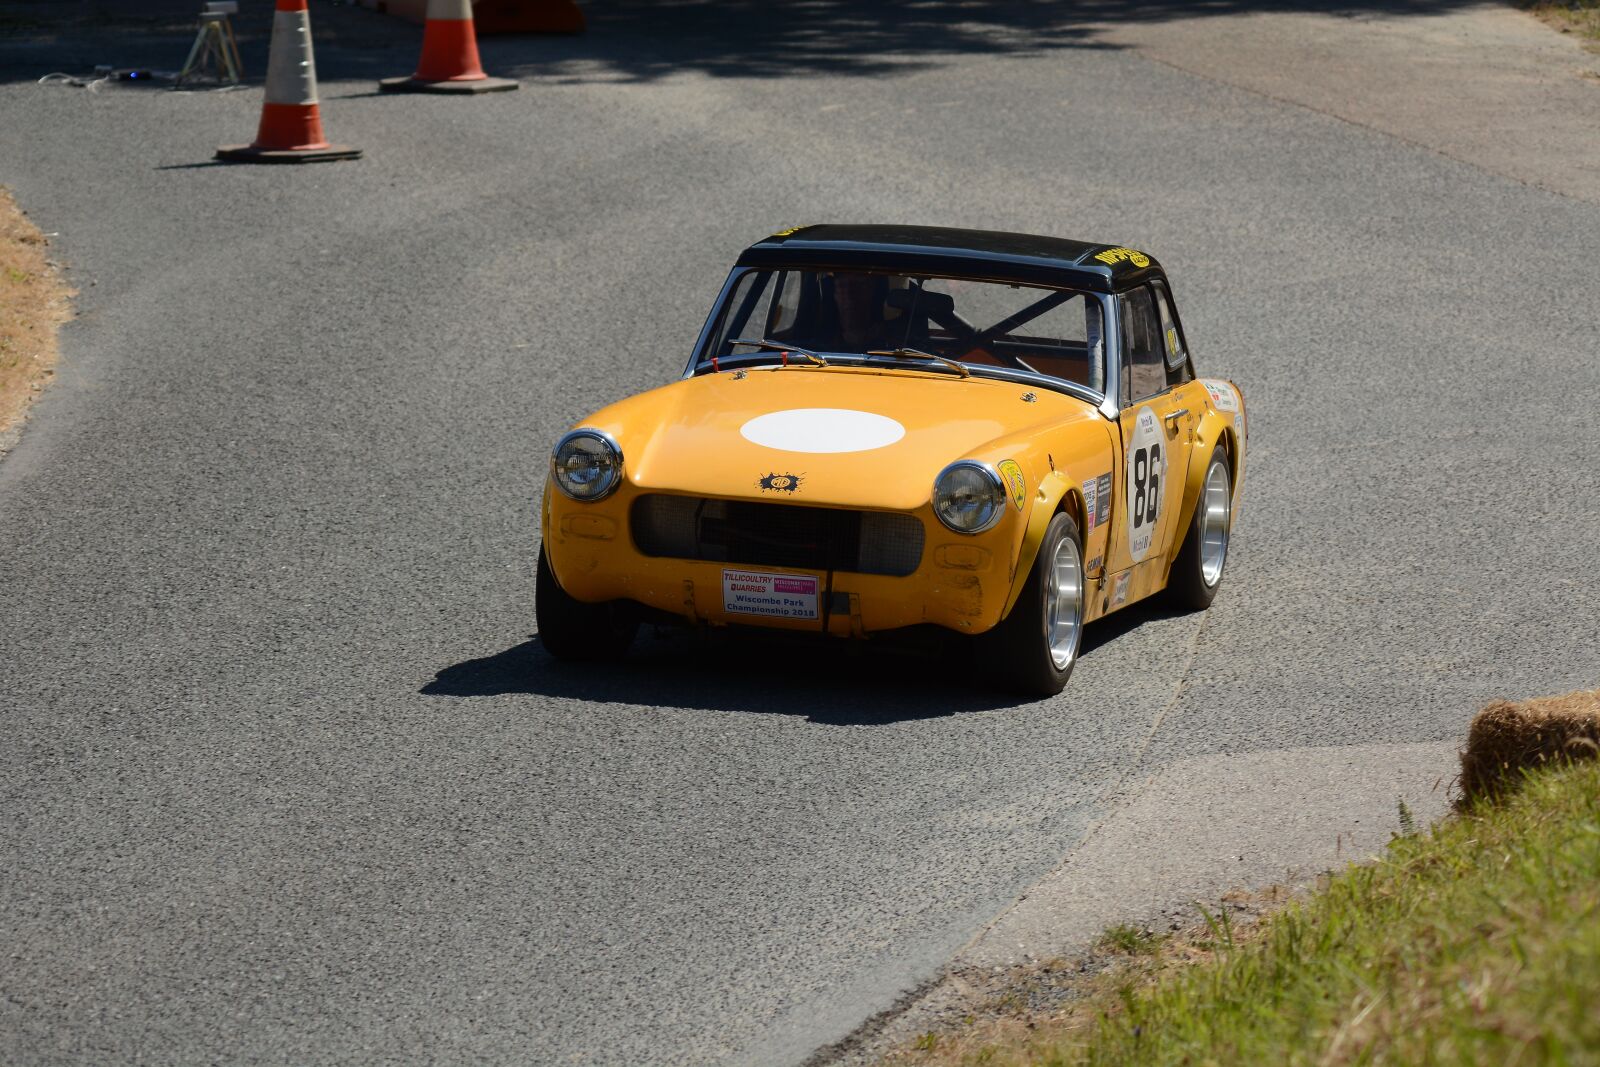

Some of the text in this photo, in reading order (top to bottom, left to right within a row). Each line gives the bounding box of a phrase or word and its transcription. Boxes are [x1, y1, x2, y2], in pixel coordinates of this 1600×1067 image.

[1134, 443, 1160, 528] 86
[725, 573, 773, 583] TILLICOULTRY
[731, 584, 766, 593] QUARRIES
[736, 594, 804, 607] Wiscombe Park
[727, 603, 815, 617] Championship 2018
